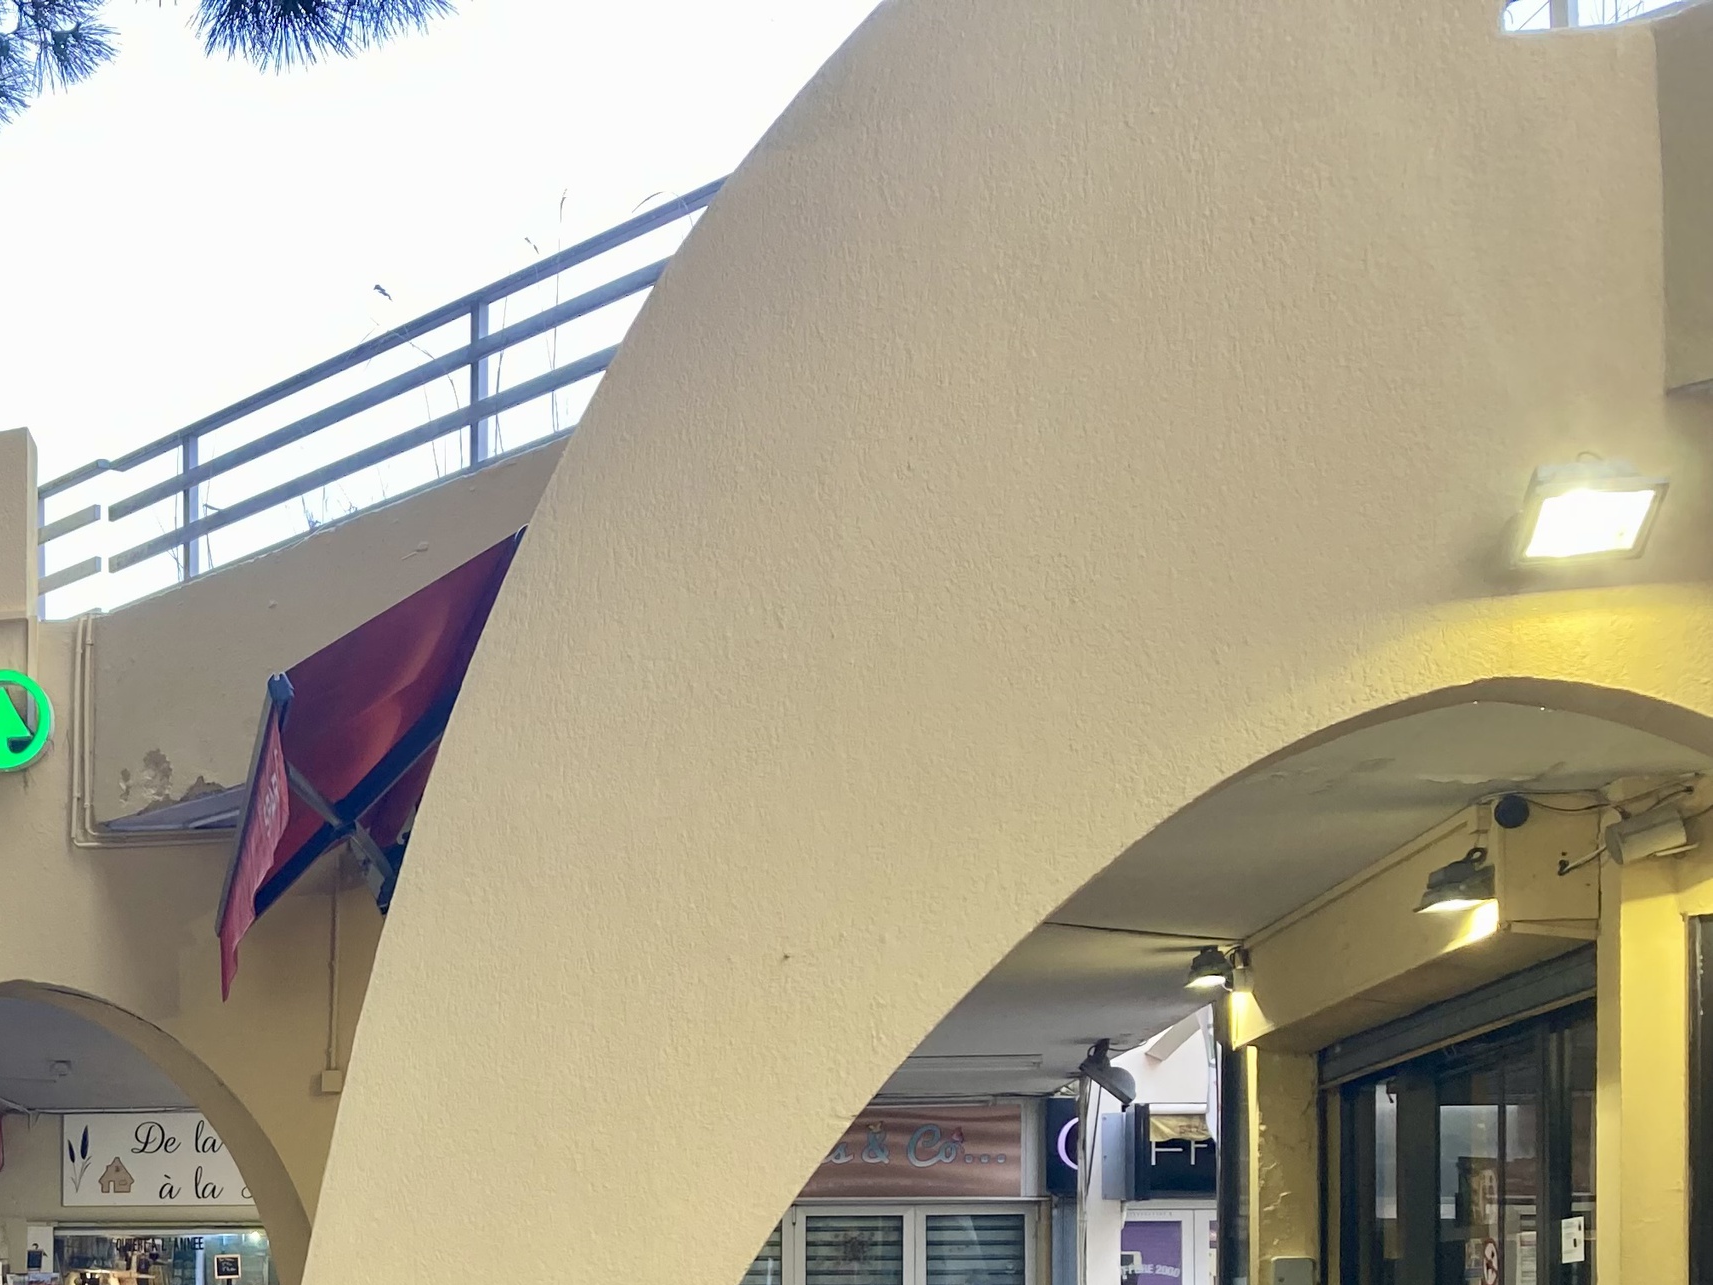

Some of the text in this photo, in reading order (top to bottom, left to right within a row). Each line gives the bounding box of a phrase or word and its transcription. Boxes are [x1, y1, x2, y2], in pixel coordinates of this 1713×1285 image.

[131, 1120, 224, 1154] De la
[159, 1174, 182, 1200] à
[194, 1166, 224, 1200] la
